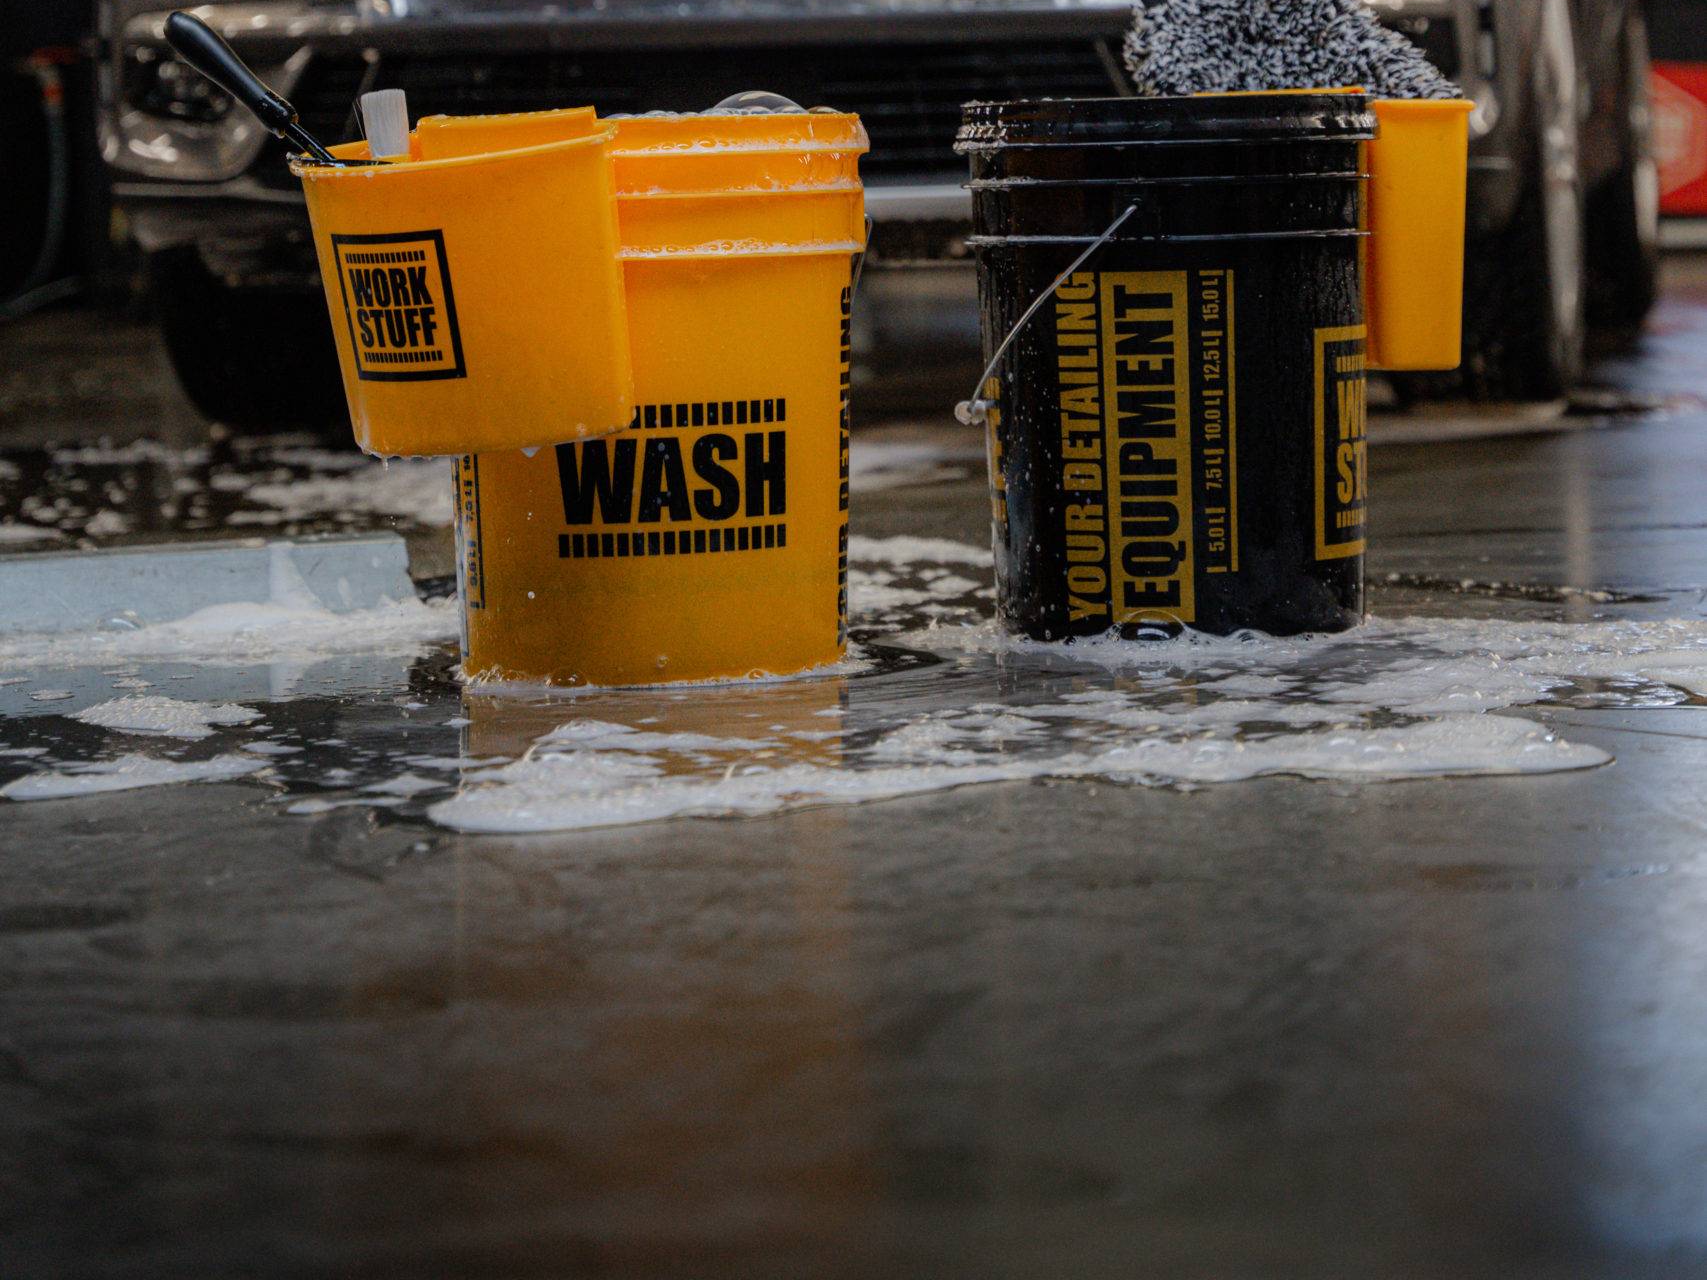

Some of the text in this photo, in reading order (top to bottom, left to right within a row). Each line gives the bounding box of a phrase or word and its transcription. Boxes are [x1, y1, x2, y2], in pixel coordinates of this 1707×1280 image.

[349, 266, 433, 308] WORK
[356, 307, 437, 348] STUFF
[555, 431, 786, 525] WASH
[1055, 271, 1107, 621] YOUR DETAILING
[1113, 284, 1187, 608] EQUIPMENT
